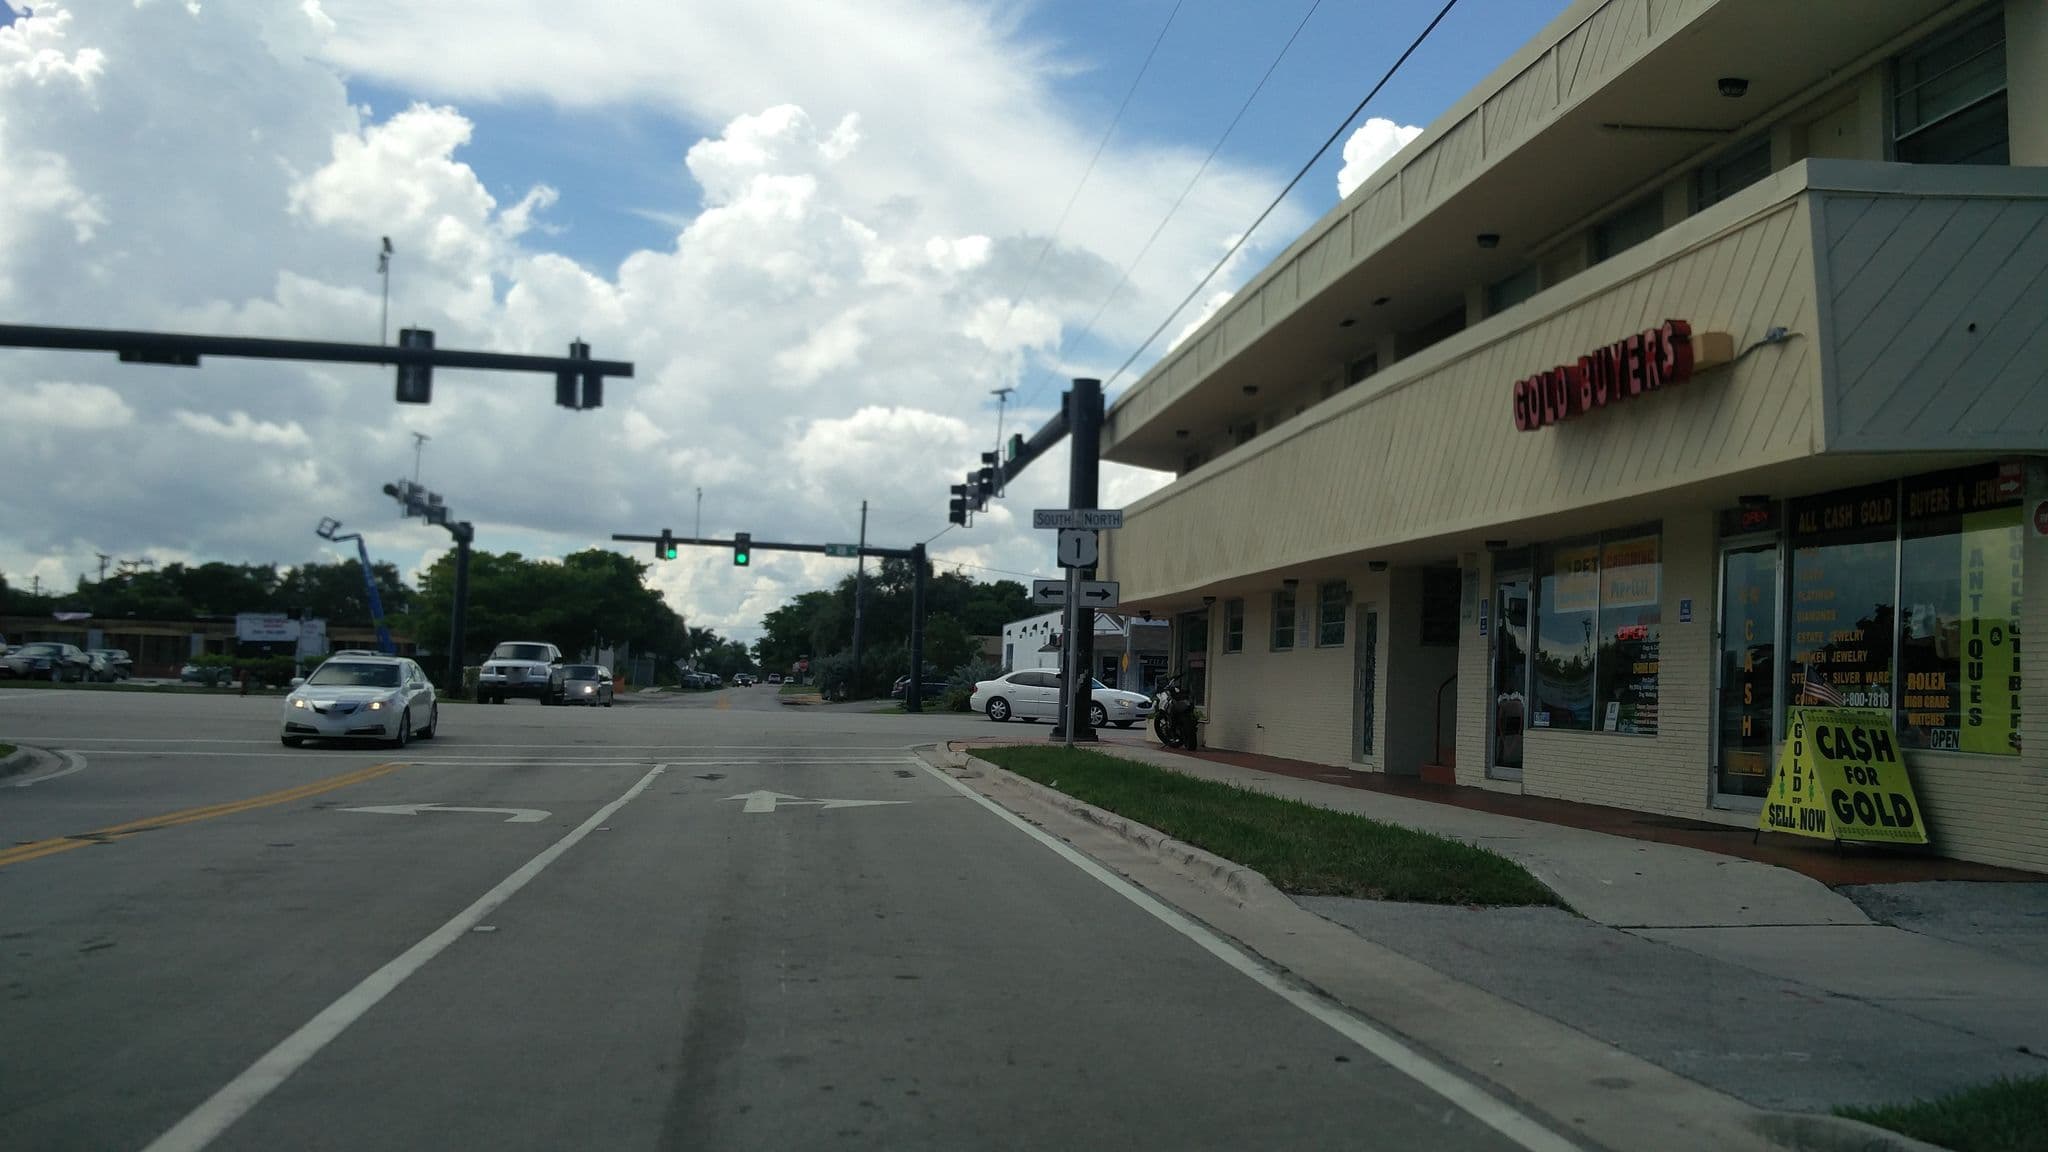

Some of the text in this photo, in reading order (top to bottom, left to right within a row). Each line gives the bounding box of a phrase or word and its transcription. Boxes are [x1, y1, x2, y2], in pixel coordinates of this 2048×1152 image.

[1514, 319, 1690, 432] GOLD BUYERS
[1084, 513, 1120, 526] NORTH
[1799, 511, 1818, 533] ALL
[1824, 504, 1854, 529] CASH
[1860, 497, 1892, 524] GOLD
[1910, 487, 1949, 518] BUYERS
[1075, 537, 1081, 559] 1
[1830, 629, 1864, 641] JEWELRY
[1967, 548, 1984, 728] ANTIQUES
[1832, 650, 1868, 663] JEWELRY
[1741, 618, 1754, 737] CASH
[1832, 671, 1861, 684] SILVER
[1865, 671, 1890, 684] WARE
[1907, 672, 1946, 690] ROLEX
[1908, 712, 1945, 726] WATCHES
[1815, 725, 1896, 764] CA$H
[1932, 730, 1960, 748] OPEN
[1793, 723, 1803, 792] GOLD
[1844, 765, 1881, 786] FOR
[1831, 788, 1915, 828] GOLD
[1800, 808, 1826, 833] NOW
